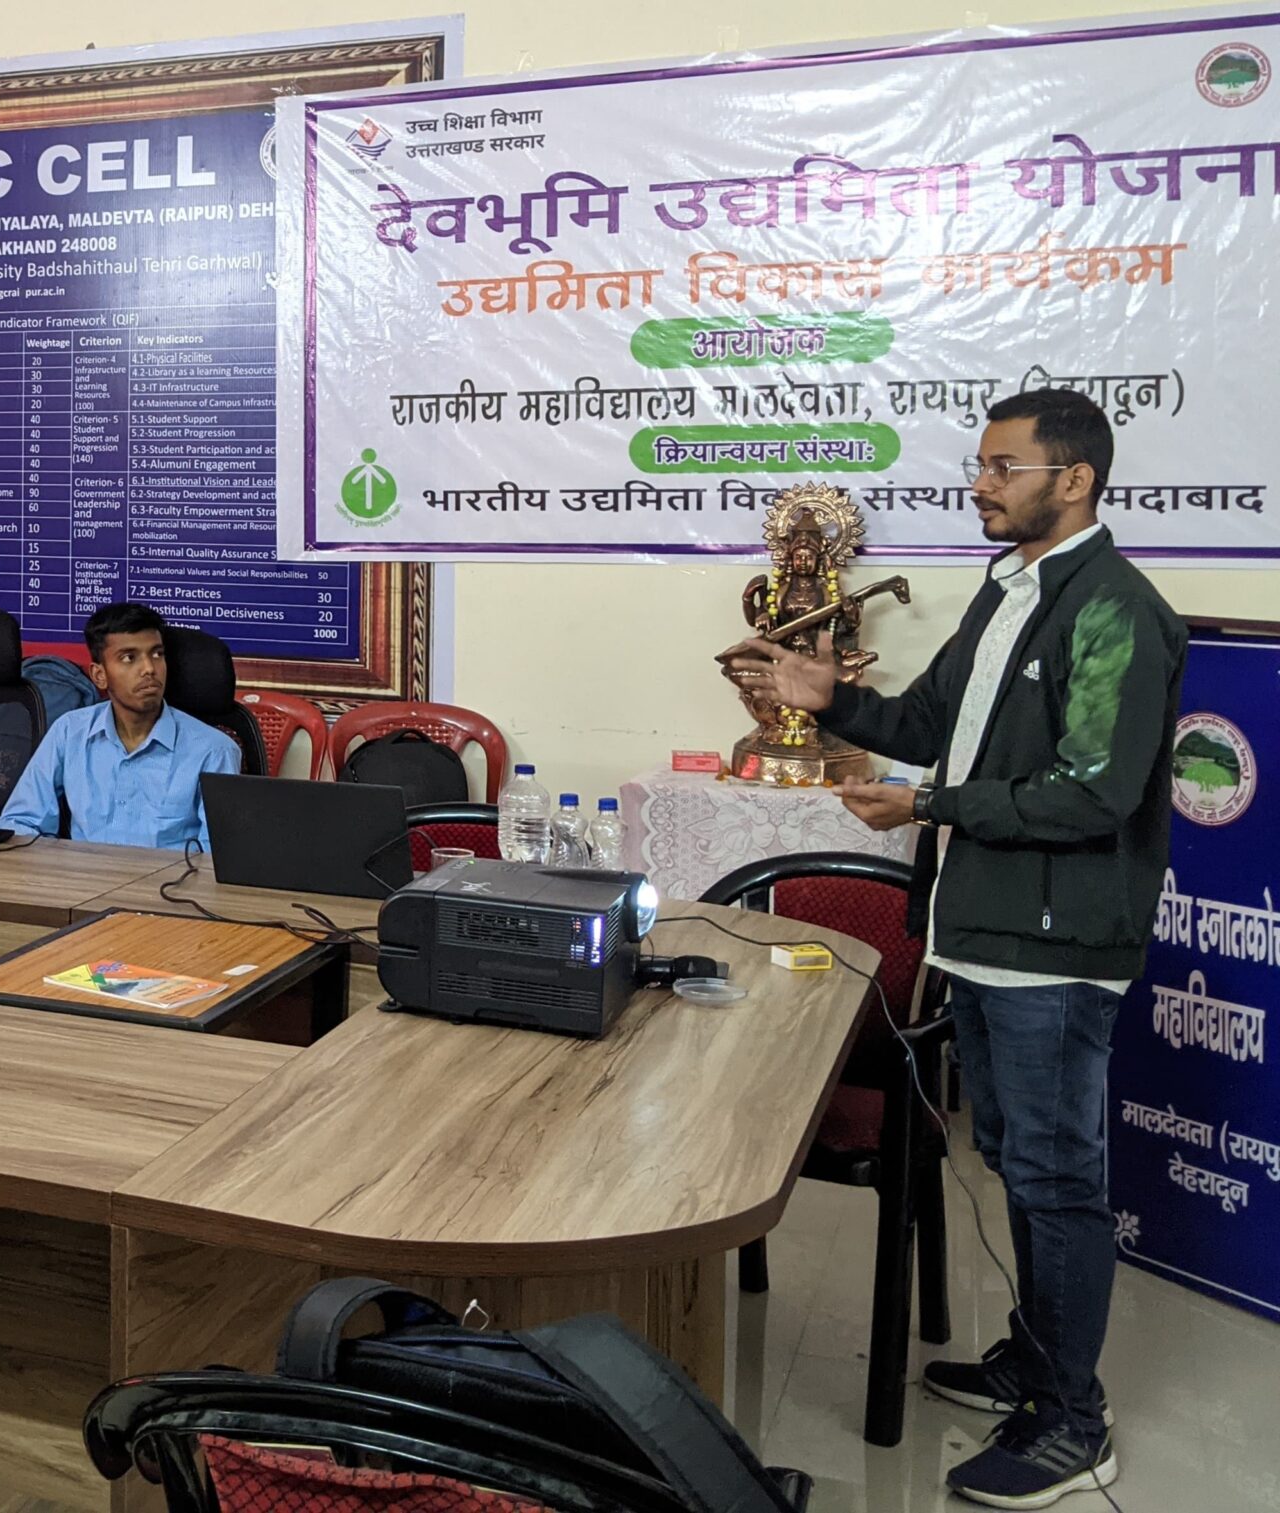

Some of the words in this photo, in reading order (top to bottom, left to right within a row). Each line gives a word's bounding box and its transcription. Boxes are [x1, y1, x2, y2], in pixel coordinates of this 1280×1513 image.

[405, 119, 439, 134] उच्च
[442, 112, 485, 131] शिक्षा
[490, 108, 543, 128] विभाग
[405, 139, 485, 159] उत्तराखण्ड
[489, 133, 546, 151] सरकार
[37, 136, 216, 196] CELL
[370, 171, 629, 256] देवभूमि
[649, 152, 981, 232] उद्यमिता
[68, 210, 154, 229] MALDEVTA
[159, 205, 234, 227] (RAIPUR)
[239, 202, 274, 218] DEH
[61, 237, 117, 253] 248008
[27, 256, 138, 278] Badshahithaul
[142, 256, 182, 273] Tehri
[187, 252, 262, 273] Garhwal)
[25, 287, 65, 299] pur.ac.in
[437, 260, 664, 318] उद्यमिता
[685, 251, 888, 307] विकास
[46, 315, 106, 328] Framework
[113, 313, 140, 326] (QIF)
[26, 337, 70, 349] Weightage
[79, 336, 121, 346] Criterion
[137, 335, 153, 346] Key
[155, 334, 203, 344] Indicators
[692, 318, 827, 360] आयोजक
[389, 378, 508, 426] राजकीय
[518, 376, 696, 426] महाविद्यालय
[714, 371, 873, 422] मालदेवता,
[132, 415, 181, 424] 5.1-Student
[183, 415, 218, 424] Support
[131, 428, 181, 437] 5.2-Student
[184, 429, 235, 438] Progression
[654, 436, 788, 465] क्रियान्वयन
[194, 460, 256, 471] Engagement
[422, 481, 549, 513] भारतीय
[561, 480, 707, 513] उद्यमिता
[129, 566, 185, 575] 7.1-Institutional
[187, 568, 210, 576] Values
[212, 568, 225, 577] and
[227, 569, 249, 577] Social
[251, 570, 308, 579] Responsibilities
[318, 572, 328, 580] 50
[130, 586, 172, 597] 7.2-Best
[174, 587, 221, 599] Practices
[318, 592, 332, 603] 30
[216, 607, 284, 620] Decisiveness
[319, 611, 332, 622] 20
[314, 629, 337, 638] 1000
[1152, 970, 1265, 1064] महाविद्यालय
[1122, 1100, 1214, 1149] मालदेवता
[1168, 1152, 1250, 1214] देहरादून
